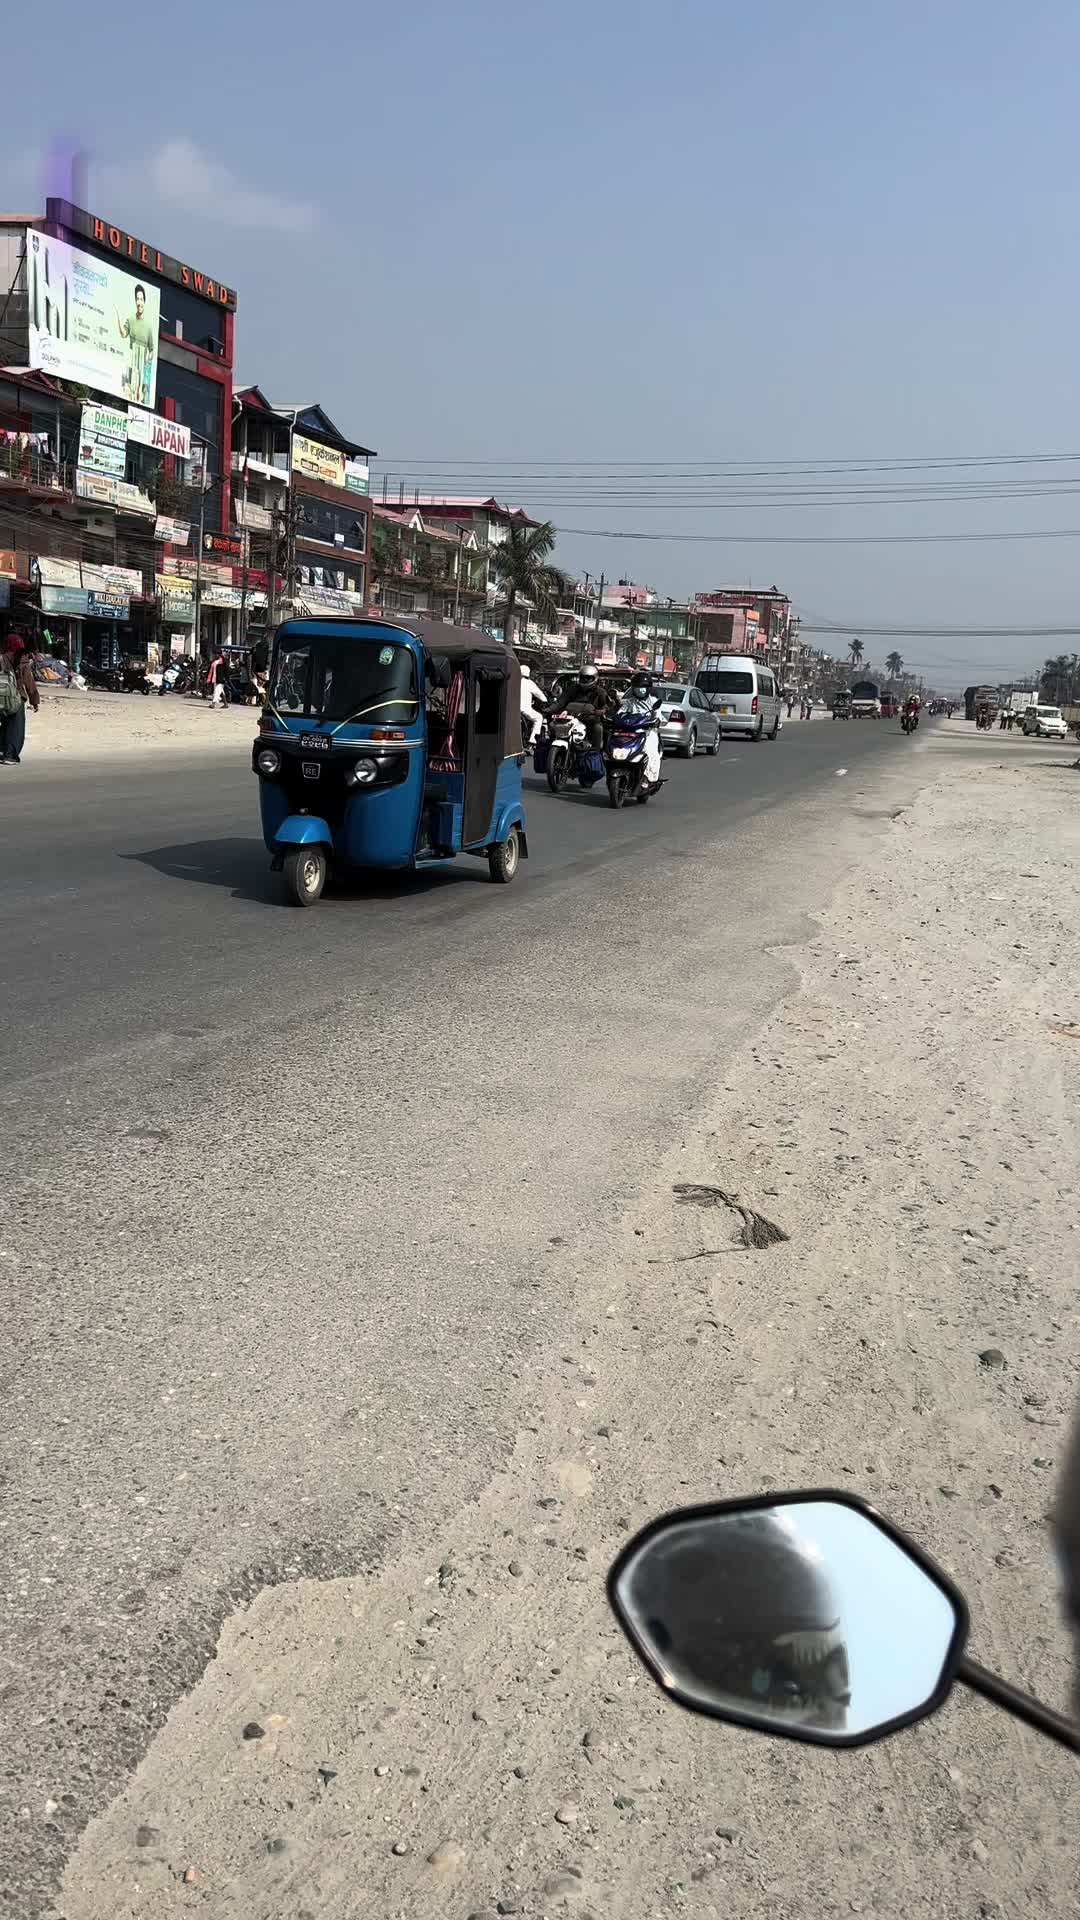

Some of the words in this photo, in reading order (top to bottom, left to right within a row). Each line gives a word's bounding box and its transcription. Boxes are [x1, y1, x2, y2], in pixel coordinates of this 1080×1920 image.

[94, 219, 163, 272] HOTEL
[182, 266, 228, 304] SWAD
[95, 411, 127, 432] DANPHE
[151, 426, 184, 455] JAPAN
